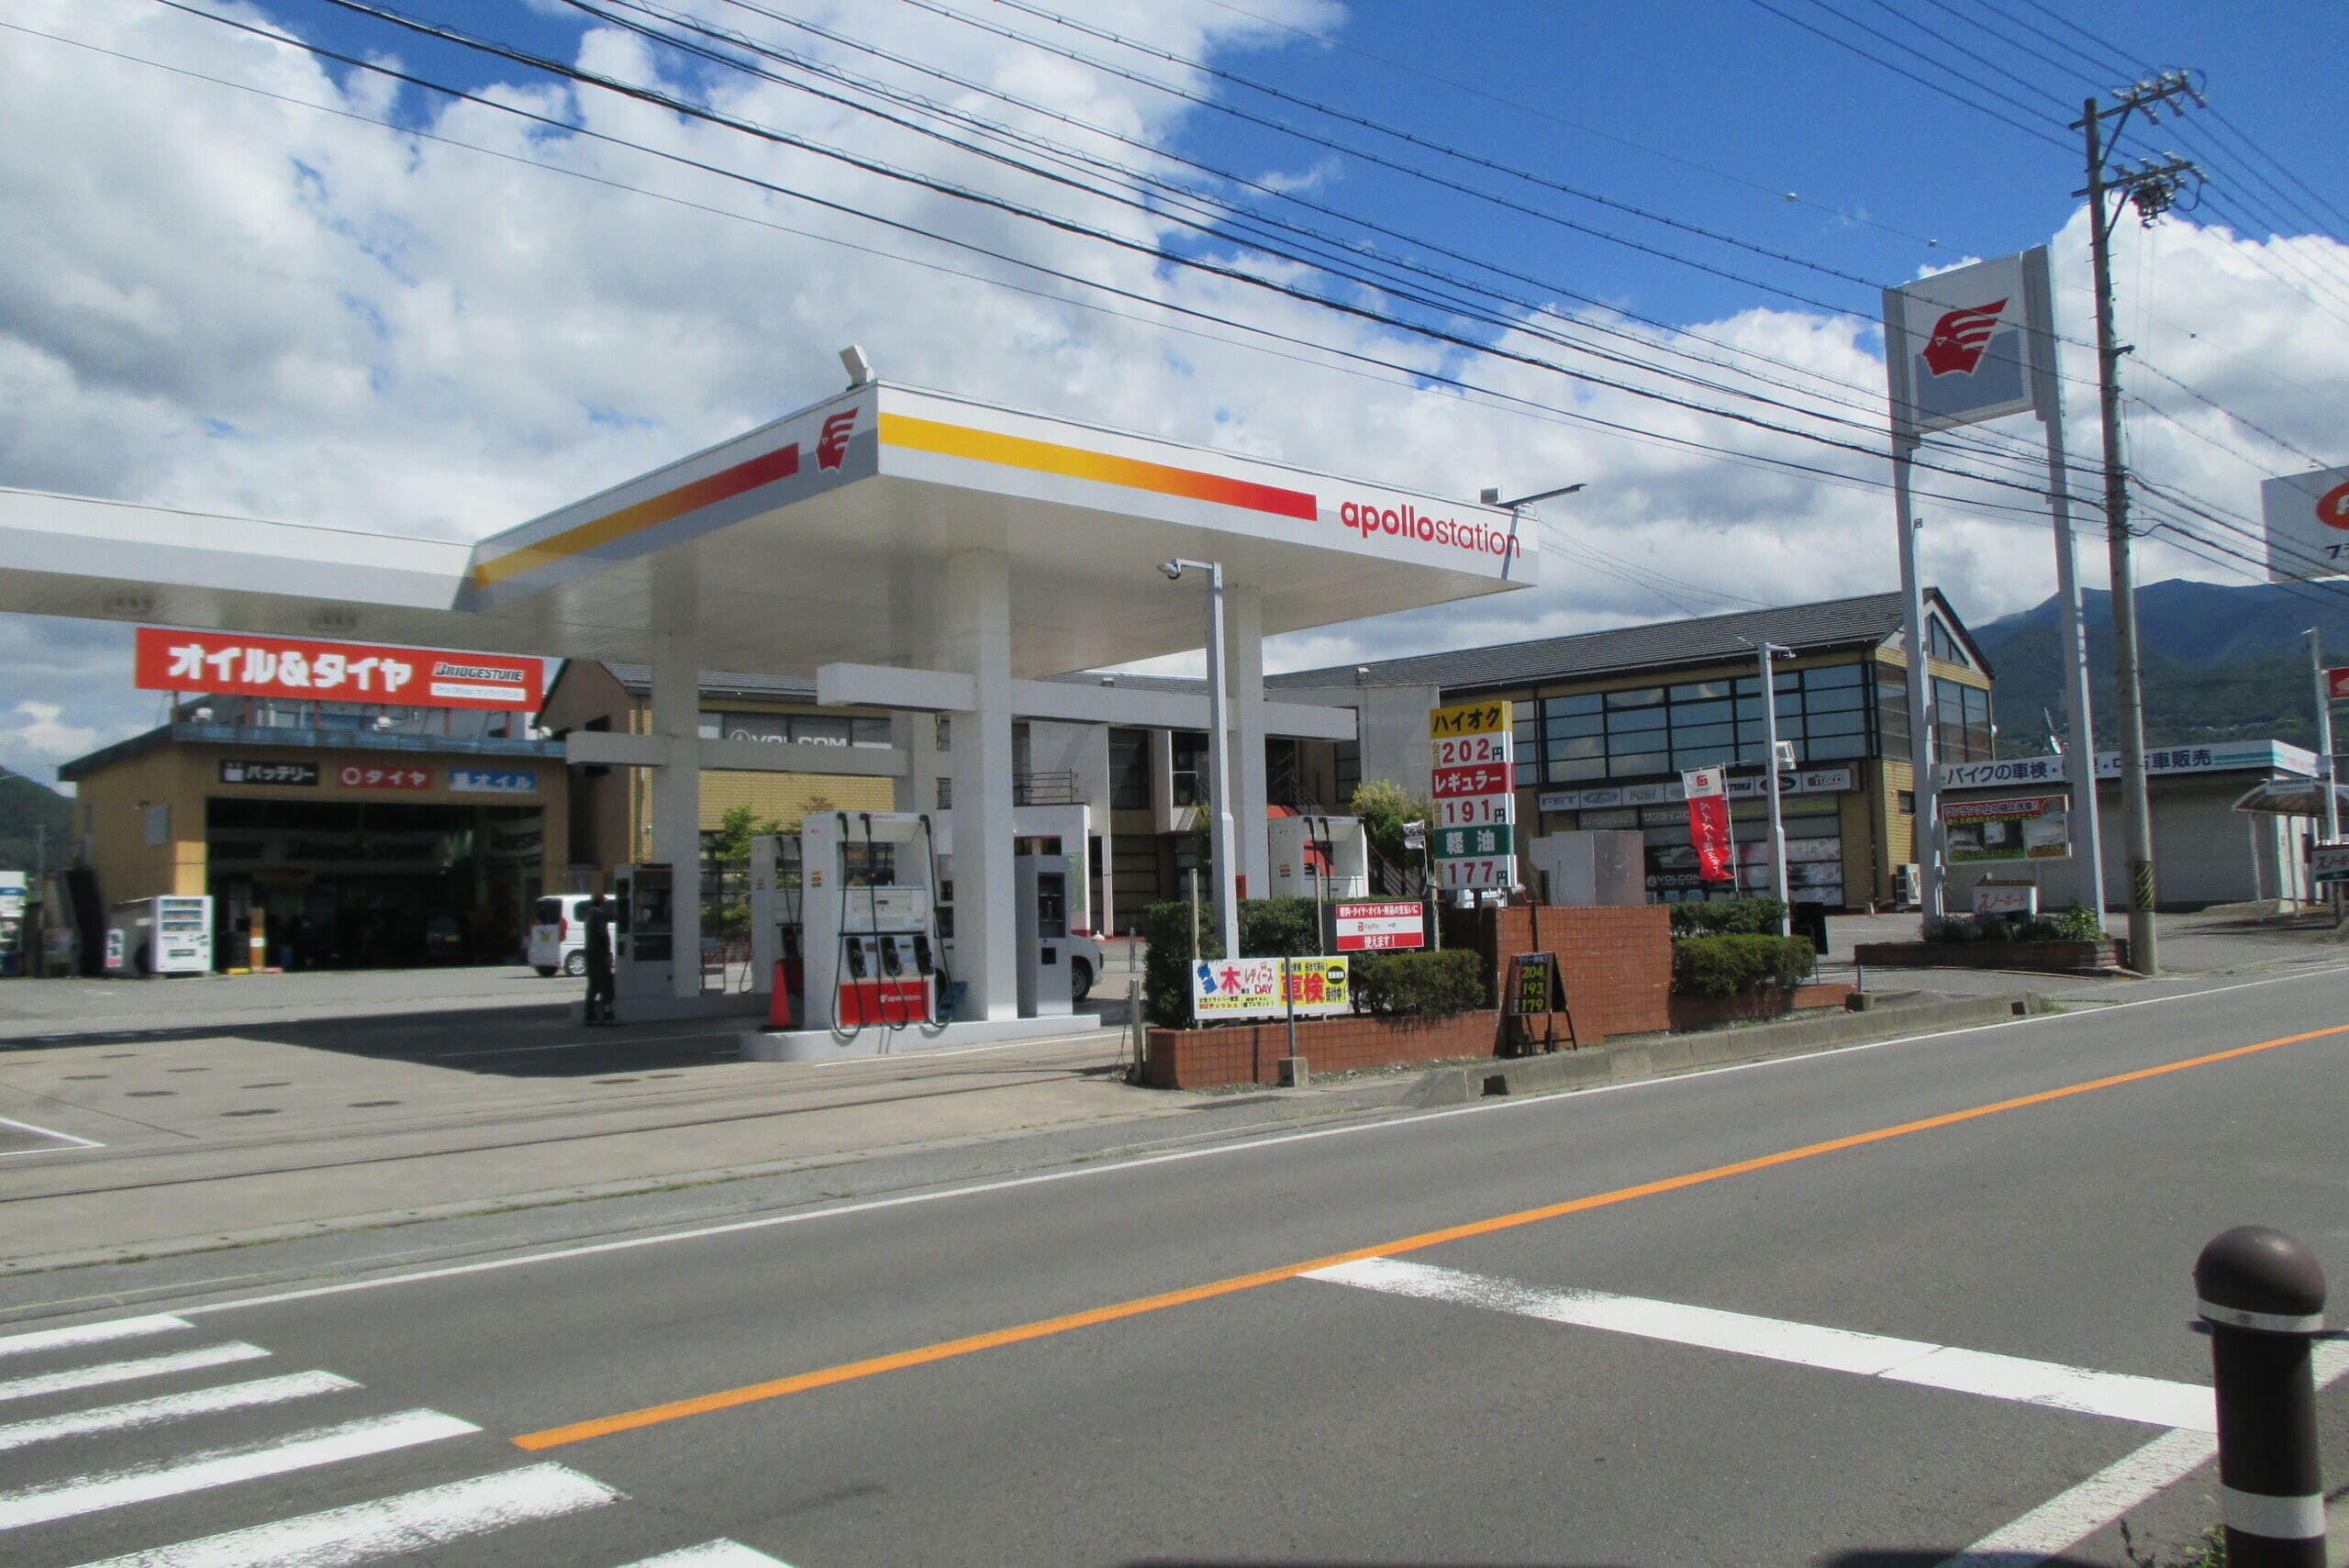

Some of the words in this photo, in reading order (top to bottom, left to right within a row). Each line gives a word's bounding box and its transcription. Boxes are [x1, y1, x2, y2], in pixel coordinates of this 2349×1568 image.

[1341, 501, 1520, 559] apollostation
[168, 643, 412, 693] オイル&タイヤ
[433, 662, 525, 682] BRIDGESTONE
[1433, 707, 1500, 732] ハイオク
[247, 765, 317, 782] バッテリー
[366, 768, 430, 786] タイヤ
[475, 772, 531, 789] オイル
[1435, 771, 1502, 793] レギュラー
[1446, 828, 1496, 854] 軽油
[1254, 984, 1273, 995] DAY
